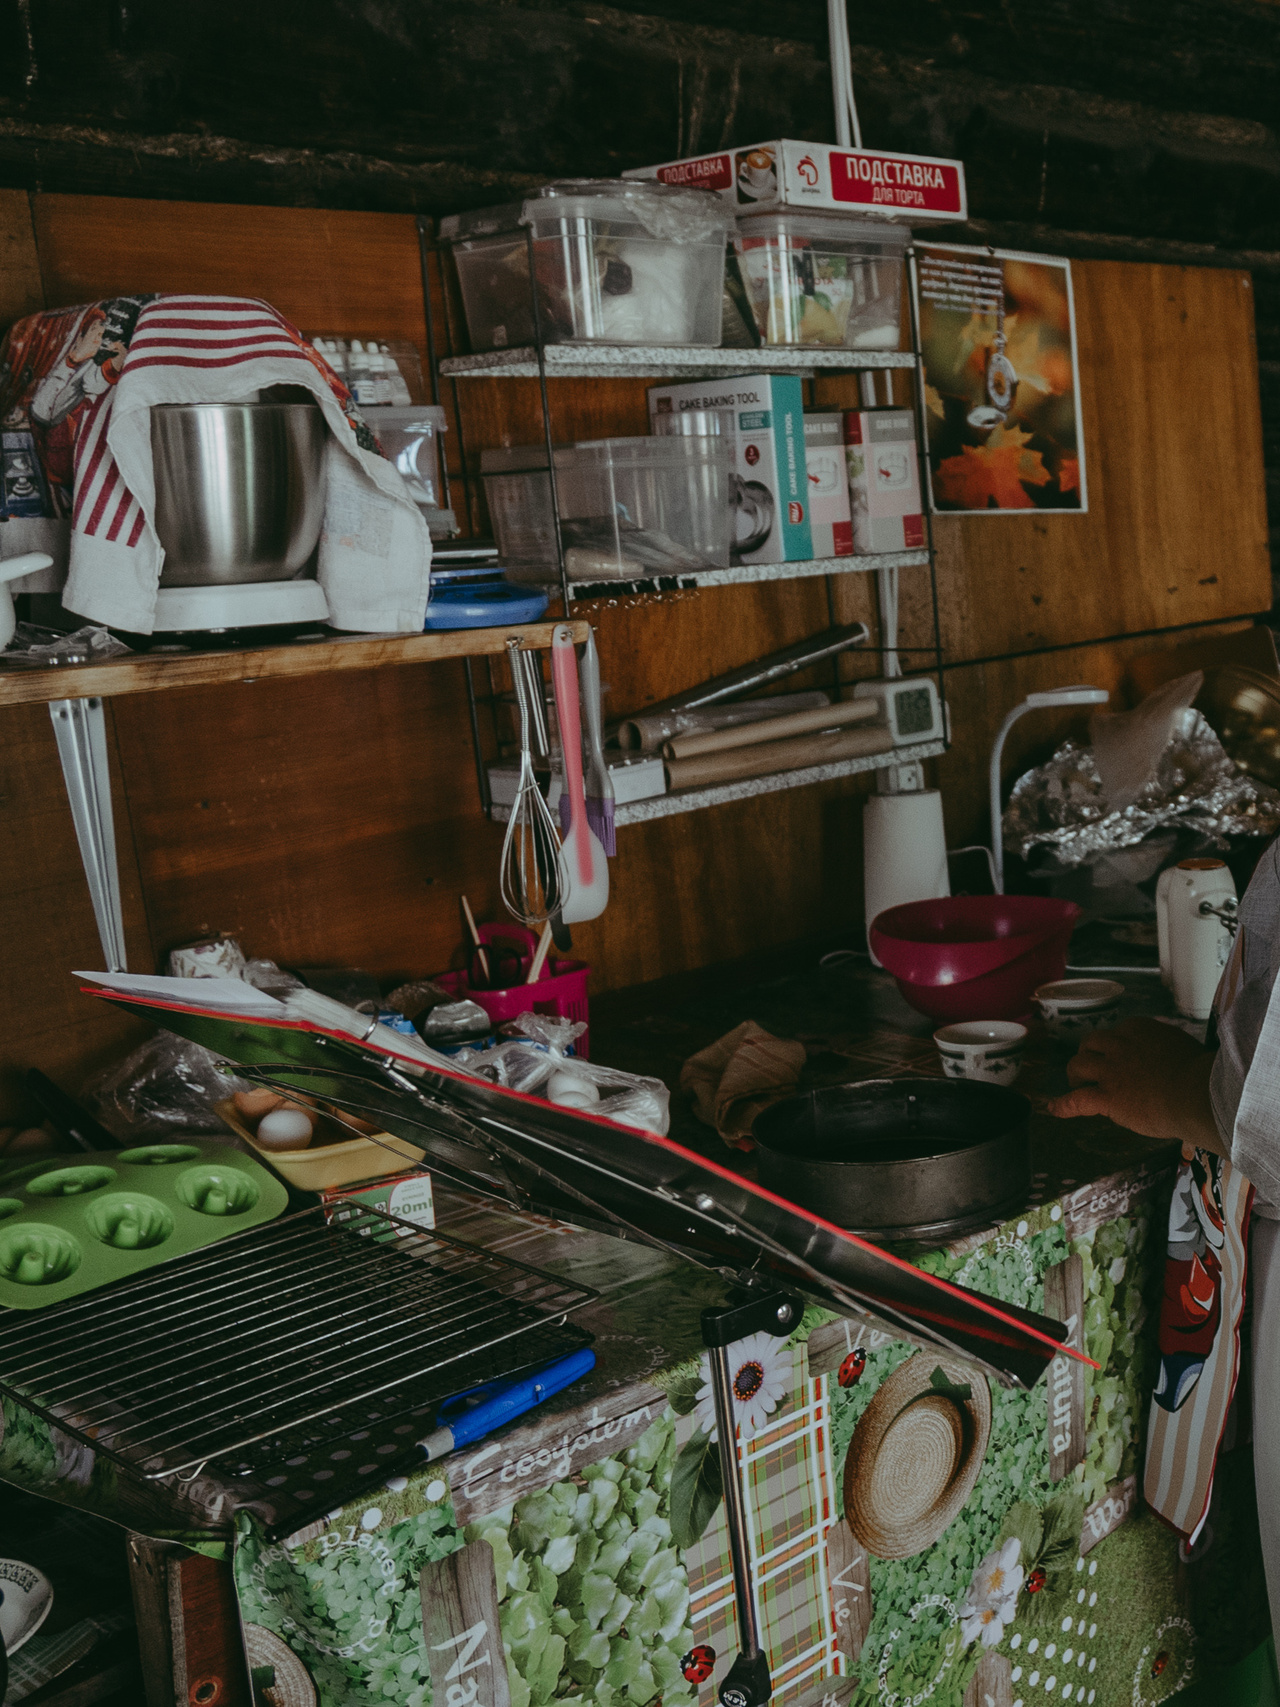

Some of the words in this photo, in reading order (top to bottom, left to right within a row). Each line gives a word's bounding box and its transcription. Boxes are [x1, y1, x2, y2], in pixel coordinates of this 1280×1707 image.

[664, 158, 725, 183] ПОДСТАВКА
[846, 157, 946, 189] ПОДСТАВКА
[872, 186, 893, 203] ДЛЯ
[895, 188, 926, 206] ТОРТА
[679, 398, 701, 411] CAKE
[703, 394, 736, 408] BAKING
[737, 391, 761, 404] TOOL
[784, 411, 793, 435] TOOL
[786, 436, 797, 470] BAKING
[788, 471, 798, 496] CAKE
[392, 1197, 432, 1217] 20ml
[317, 1525, 401, 1597] planet
